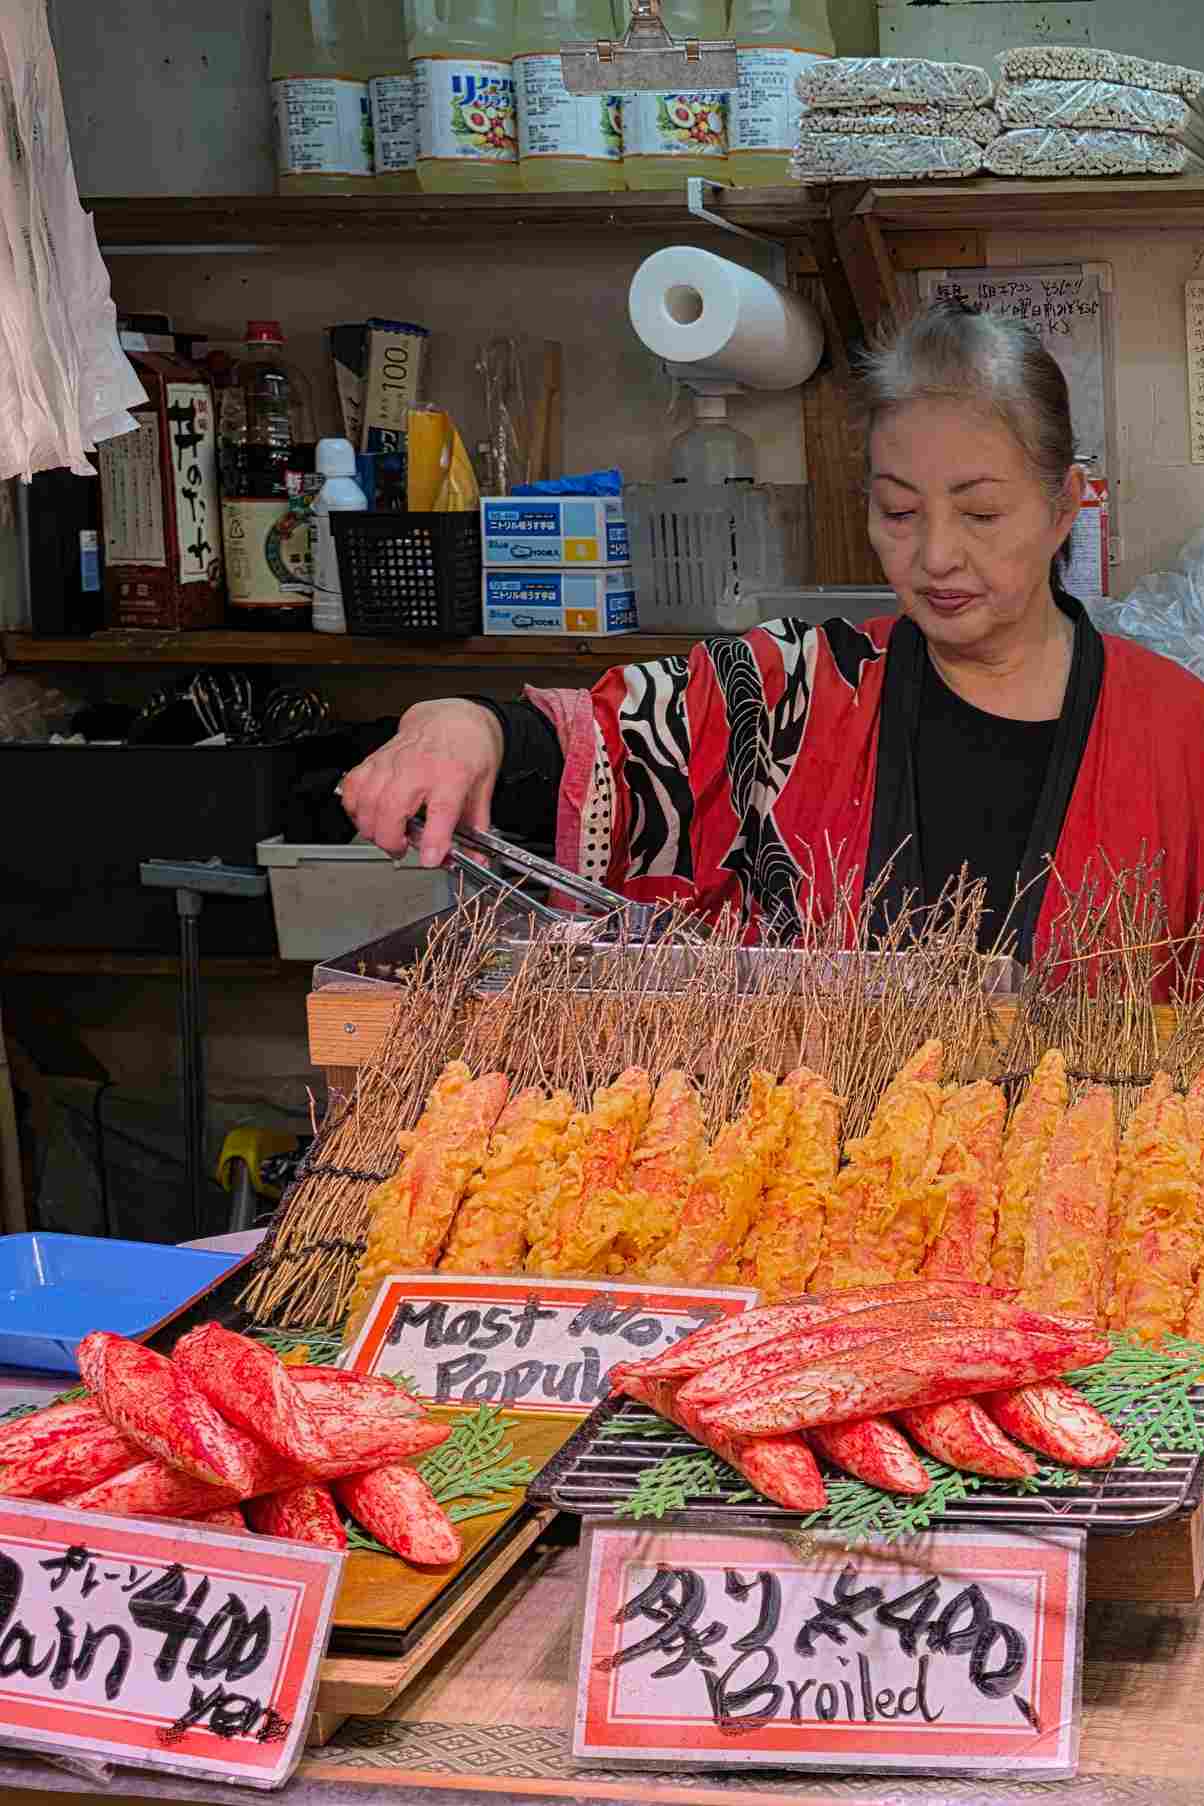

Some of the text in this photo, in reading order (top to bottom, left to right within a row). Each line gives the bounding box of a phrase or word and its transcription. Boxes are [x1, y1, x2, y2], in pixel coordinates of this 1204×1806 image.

[386, 1294, 558, 1350] Most
[432, 1346, 612, 1406] Popul
[700, 1646, 944, 1737] Broiled
